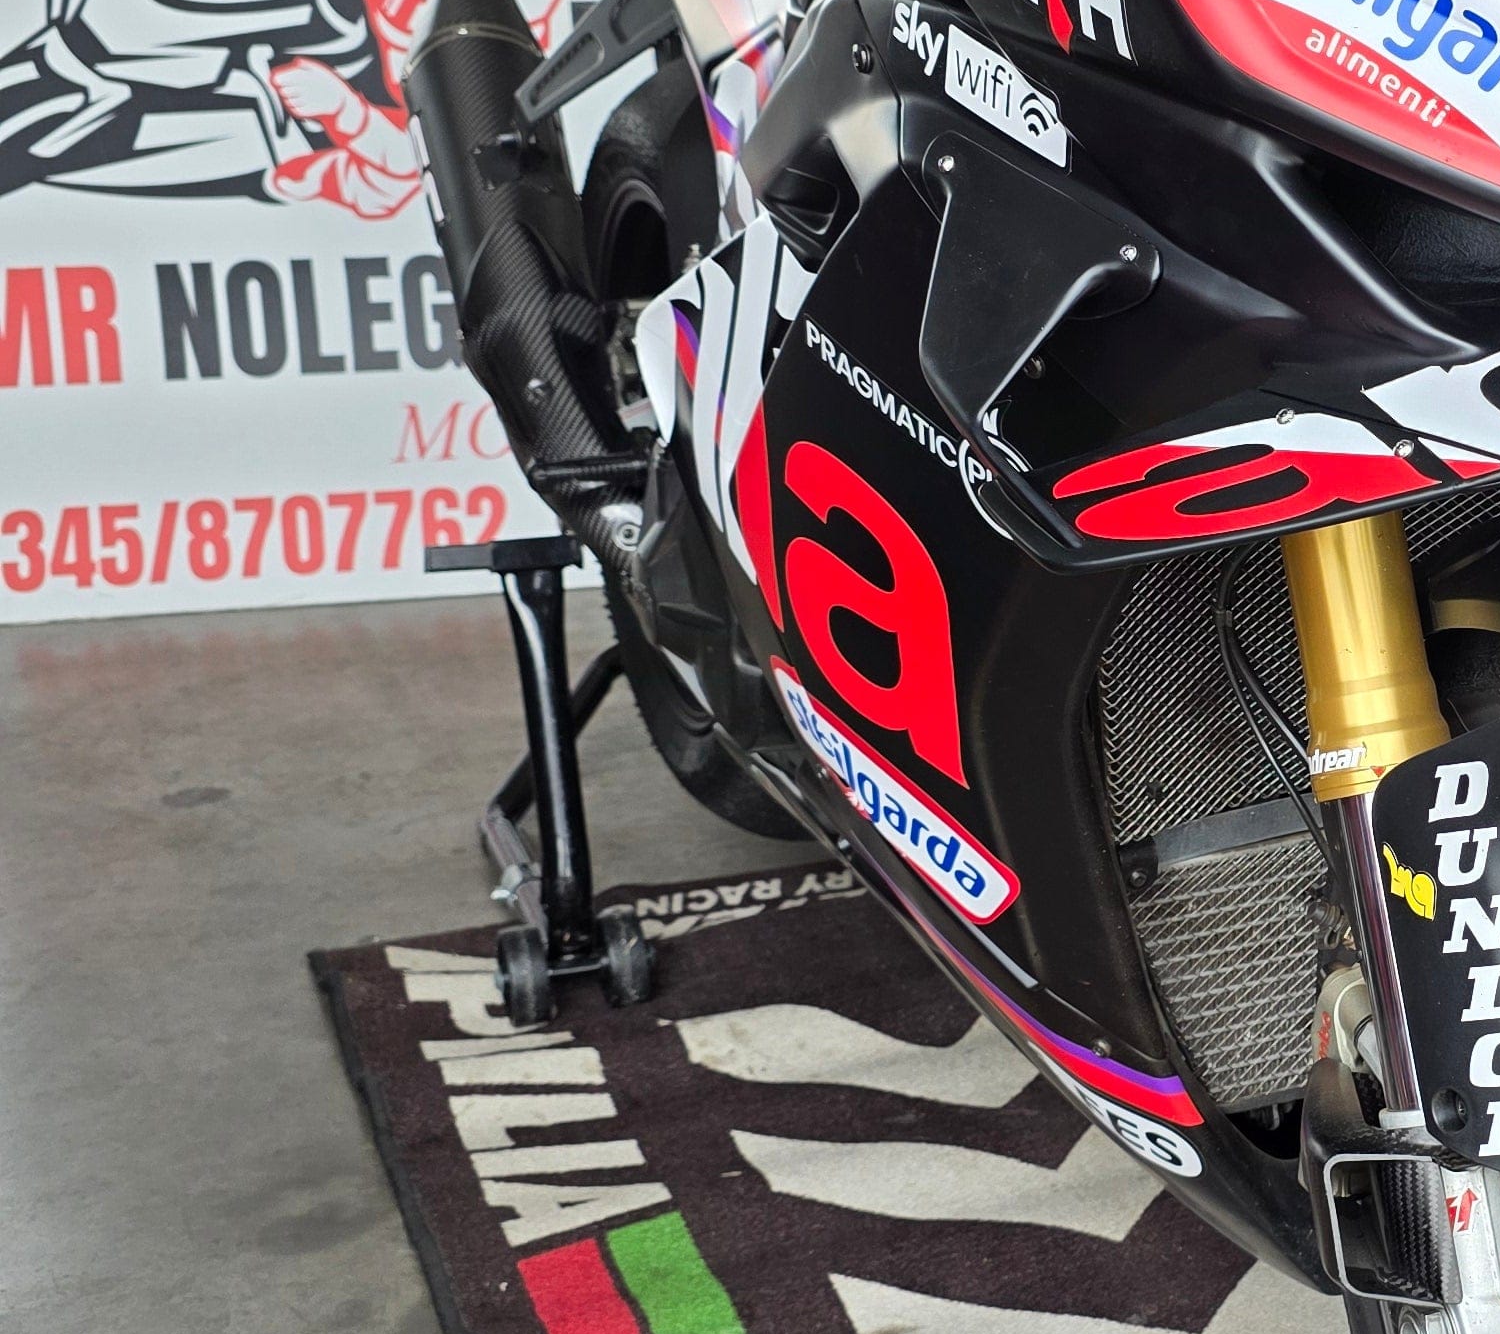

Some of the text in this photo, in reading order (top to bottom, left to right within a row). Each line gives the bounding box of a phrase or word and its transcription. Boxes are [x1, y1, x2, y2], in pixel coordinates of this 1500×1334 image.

[893, 1, 1015, 119] sky wifi
[1304, 27, 1452, 129] alimenti
[155, 255, 464, 383] NOLEG
[806, 319, 958, 467] PRAGMATIC
